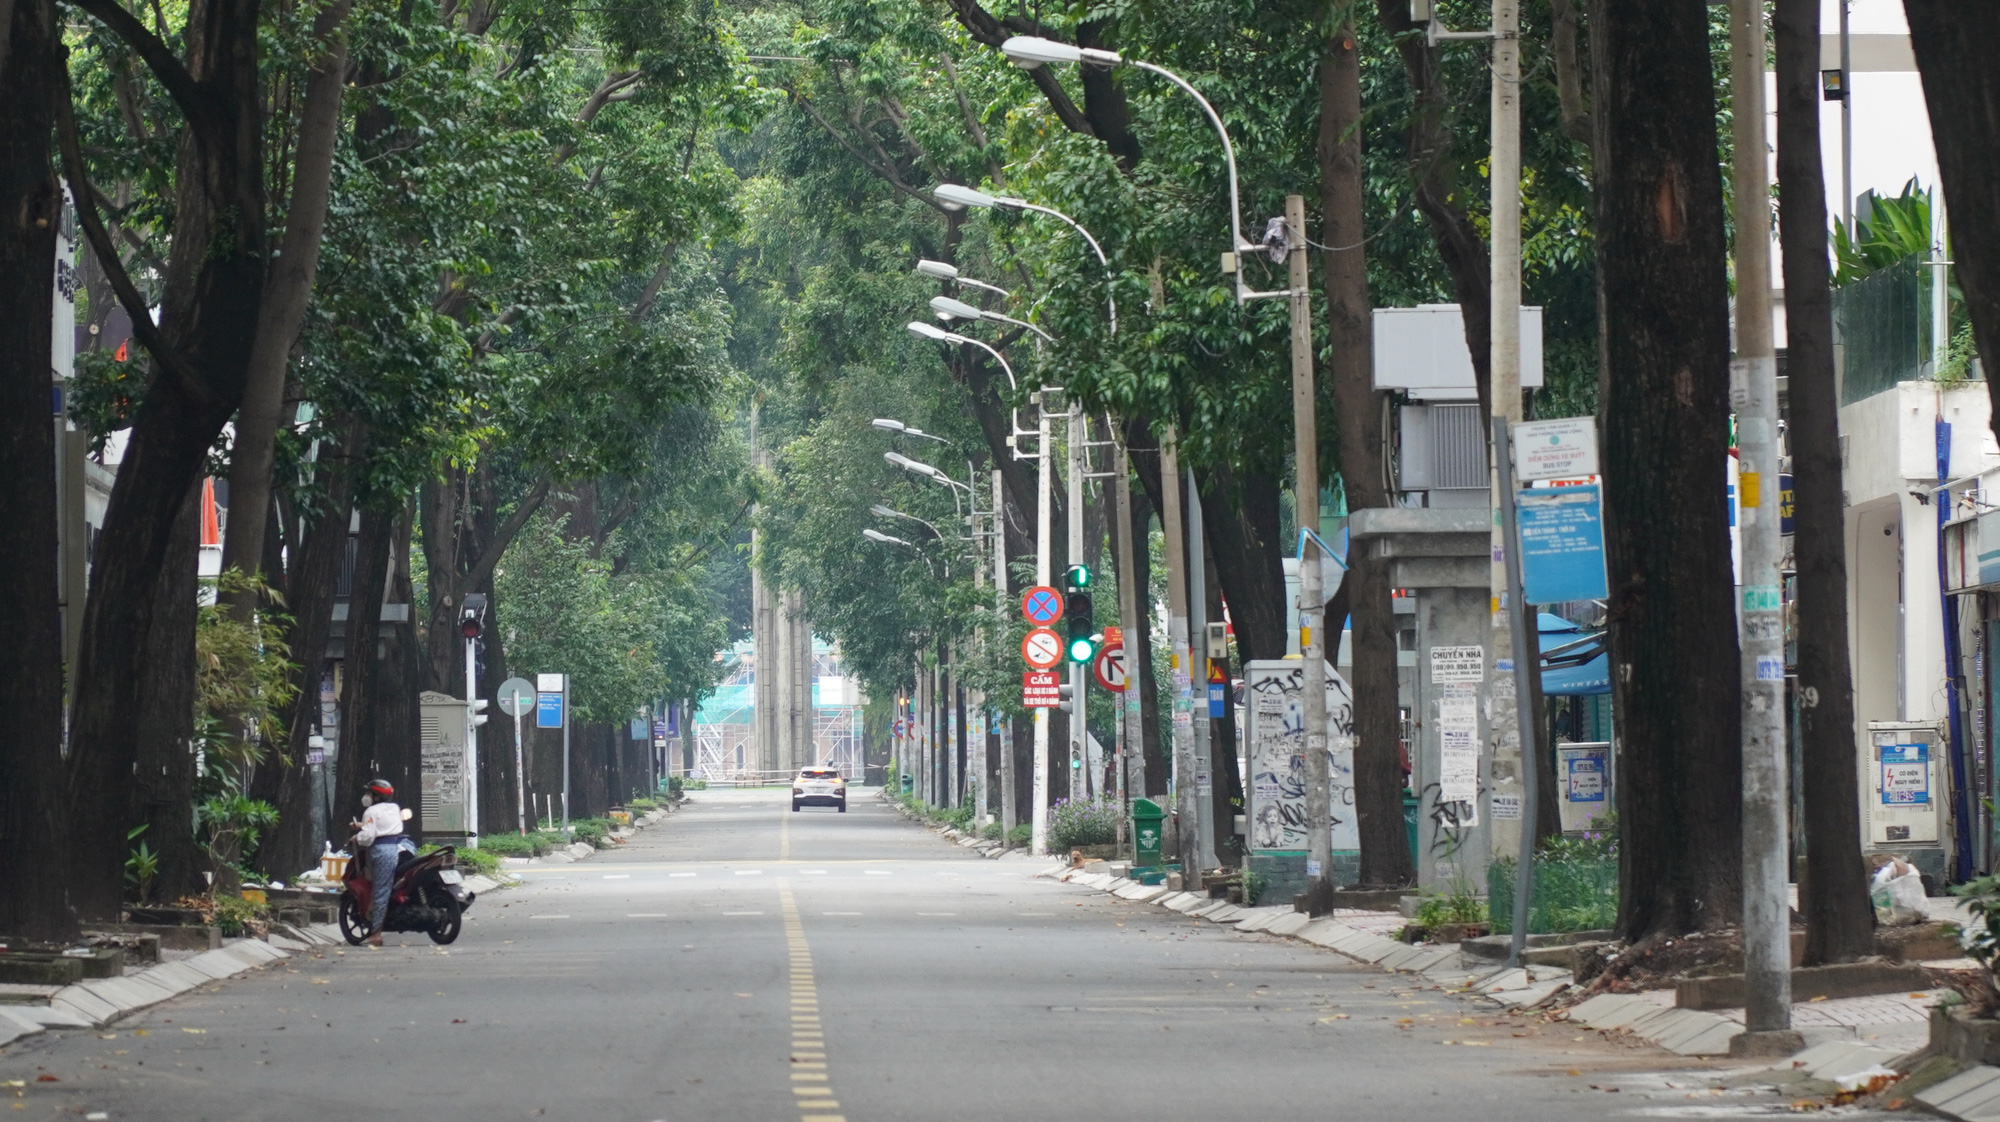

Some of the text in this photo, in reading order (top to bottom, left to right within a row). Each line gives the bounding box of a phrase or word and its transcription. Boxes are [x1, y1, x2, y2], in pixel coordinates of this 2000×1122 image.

[1432, 648, 1481, 659] CHUYỂN NHÀ
[1030, 674, 1053, 684] CẤM
